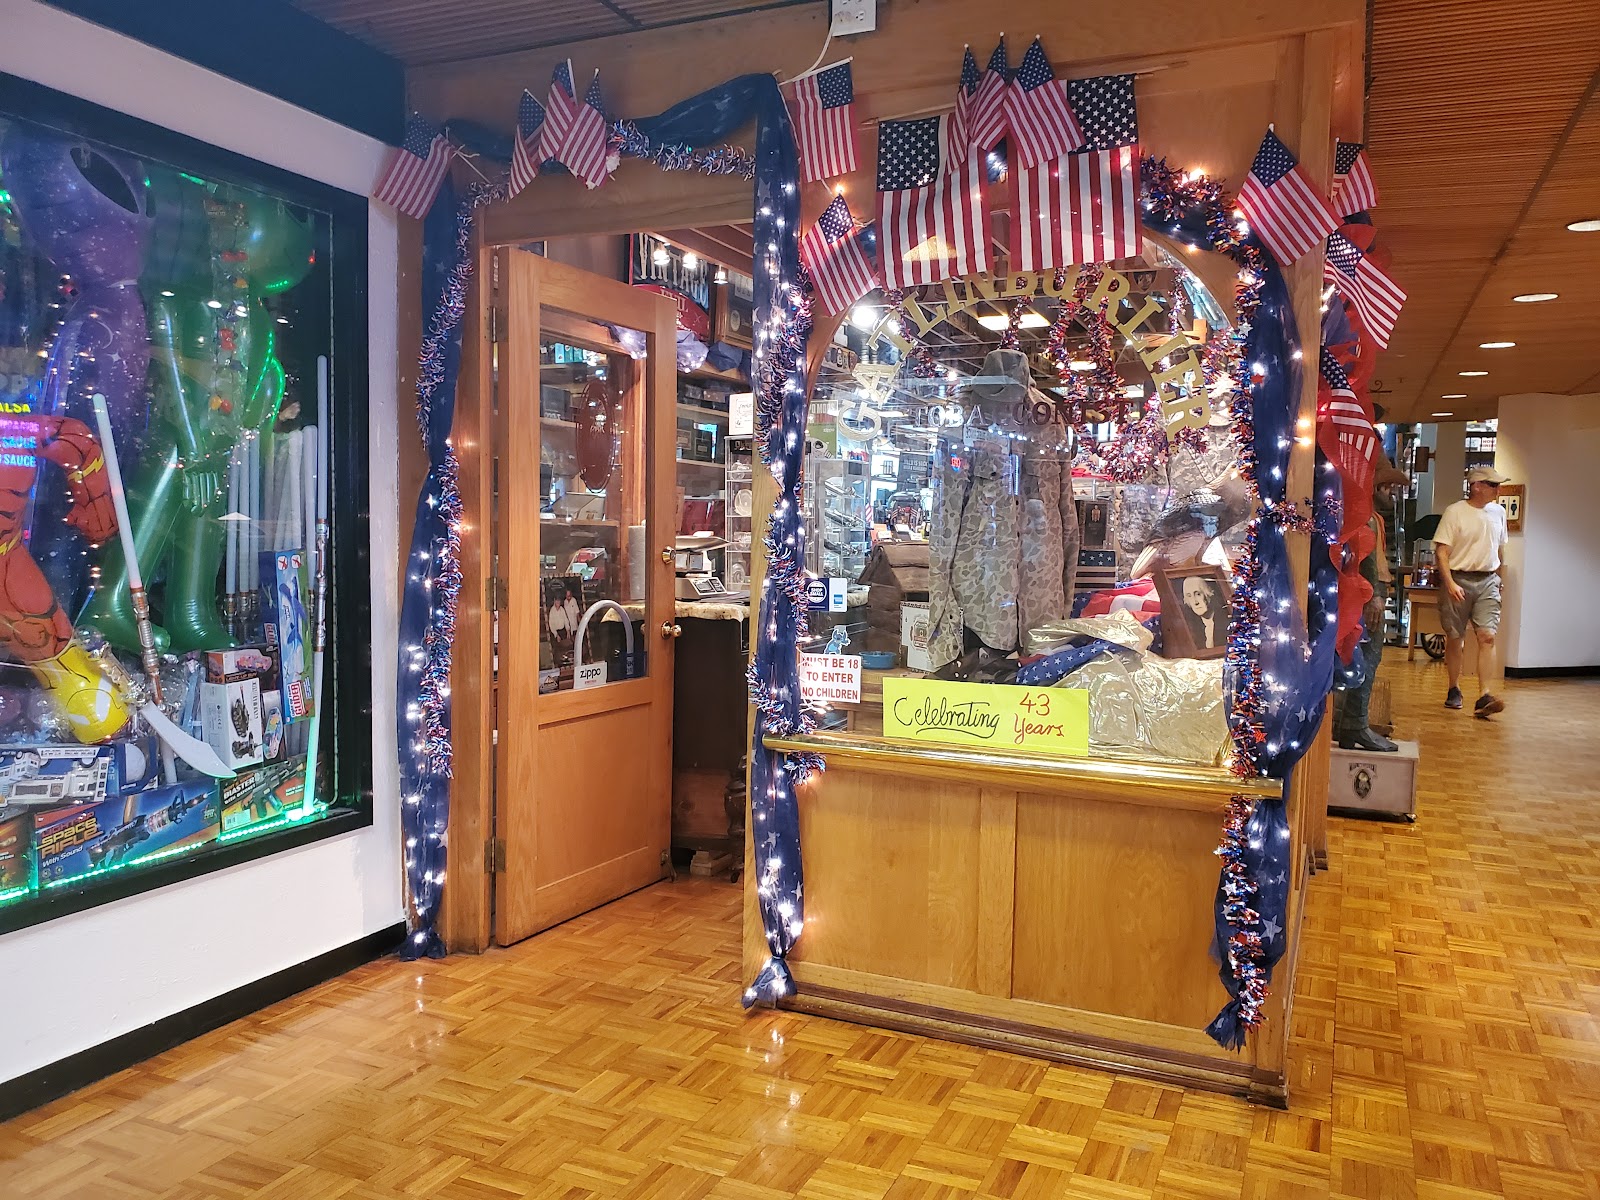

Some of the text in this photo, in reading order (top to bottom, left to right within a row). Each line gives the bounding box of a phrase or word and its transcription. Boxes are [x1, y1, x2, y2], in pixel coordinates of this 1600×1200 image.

[914, 400, 1135, 428] TOBACONIST
[4, 454, 37, 467] SAUCE
[832, 658, 844, 668] BE
[848, 659, 859, 669] 18
[580, 667, 602, 679] zippo
[806, 671, 854, 683] TO ENTER
[802, 687, 858, 700] NO CHILDREN
[894, 692, 1050, 739] Celebrating 43
[223, 776, 256, 800] BLASTER
[60, 845, 84, 860] Sound
